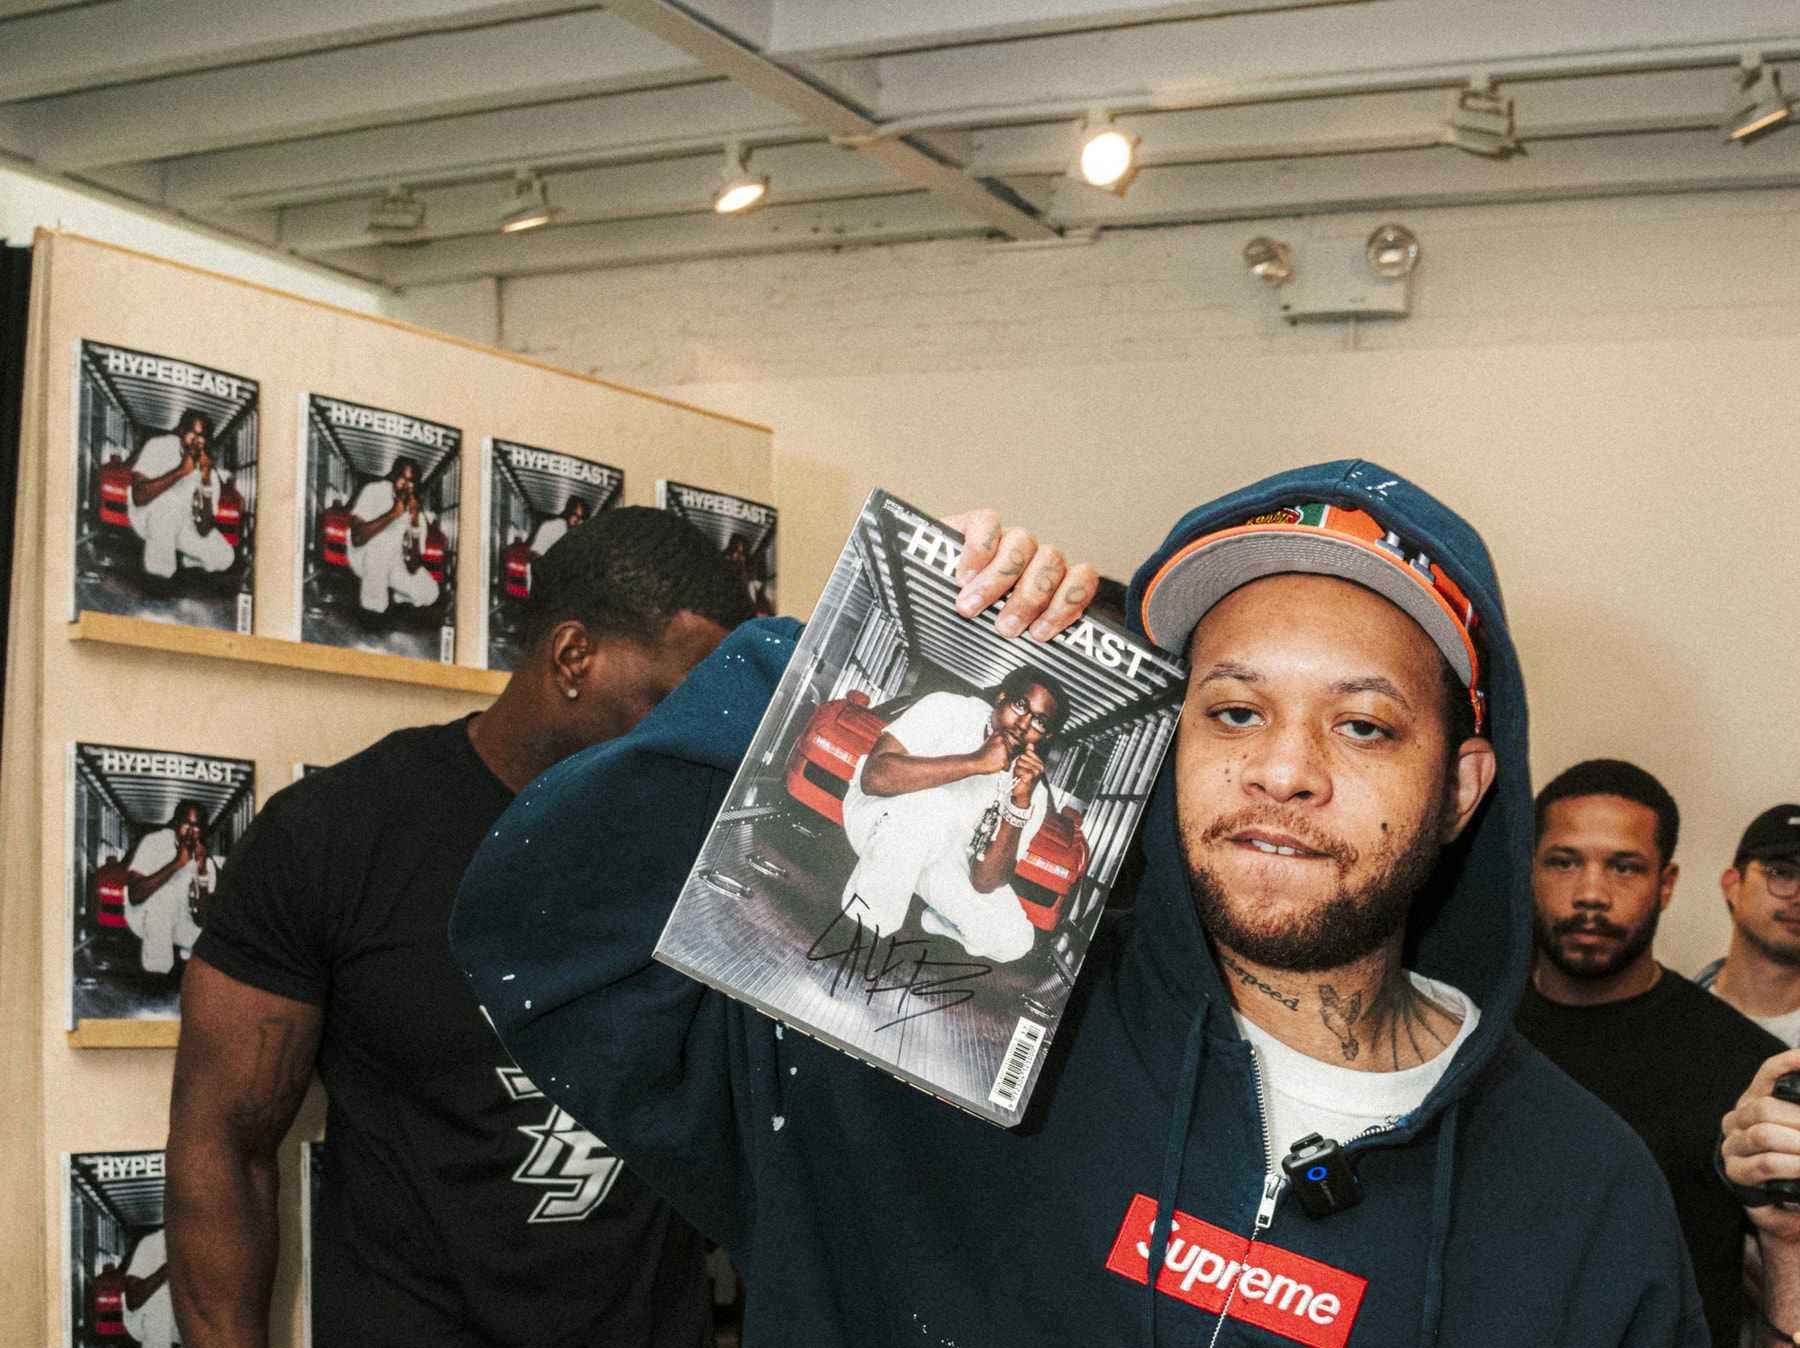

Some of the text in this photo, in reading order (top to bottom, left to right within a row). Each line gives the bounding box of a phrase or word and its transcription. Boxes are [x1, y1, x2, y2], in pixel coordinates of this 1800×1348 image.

[108, 351, 243, 399] HYPEBEAST
[331, 406, 447, 448] HYPEBEAST
[511, 448, 612, 488] HYPEBEAST
[682, 489, 769, 526] HYPEBEAST
[906, 524, 1153, 679] HYAST
[103, 751, 236, 783] HYPEBEAST
